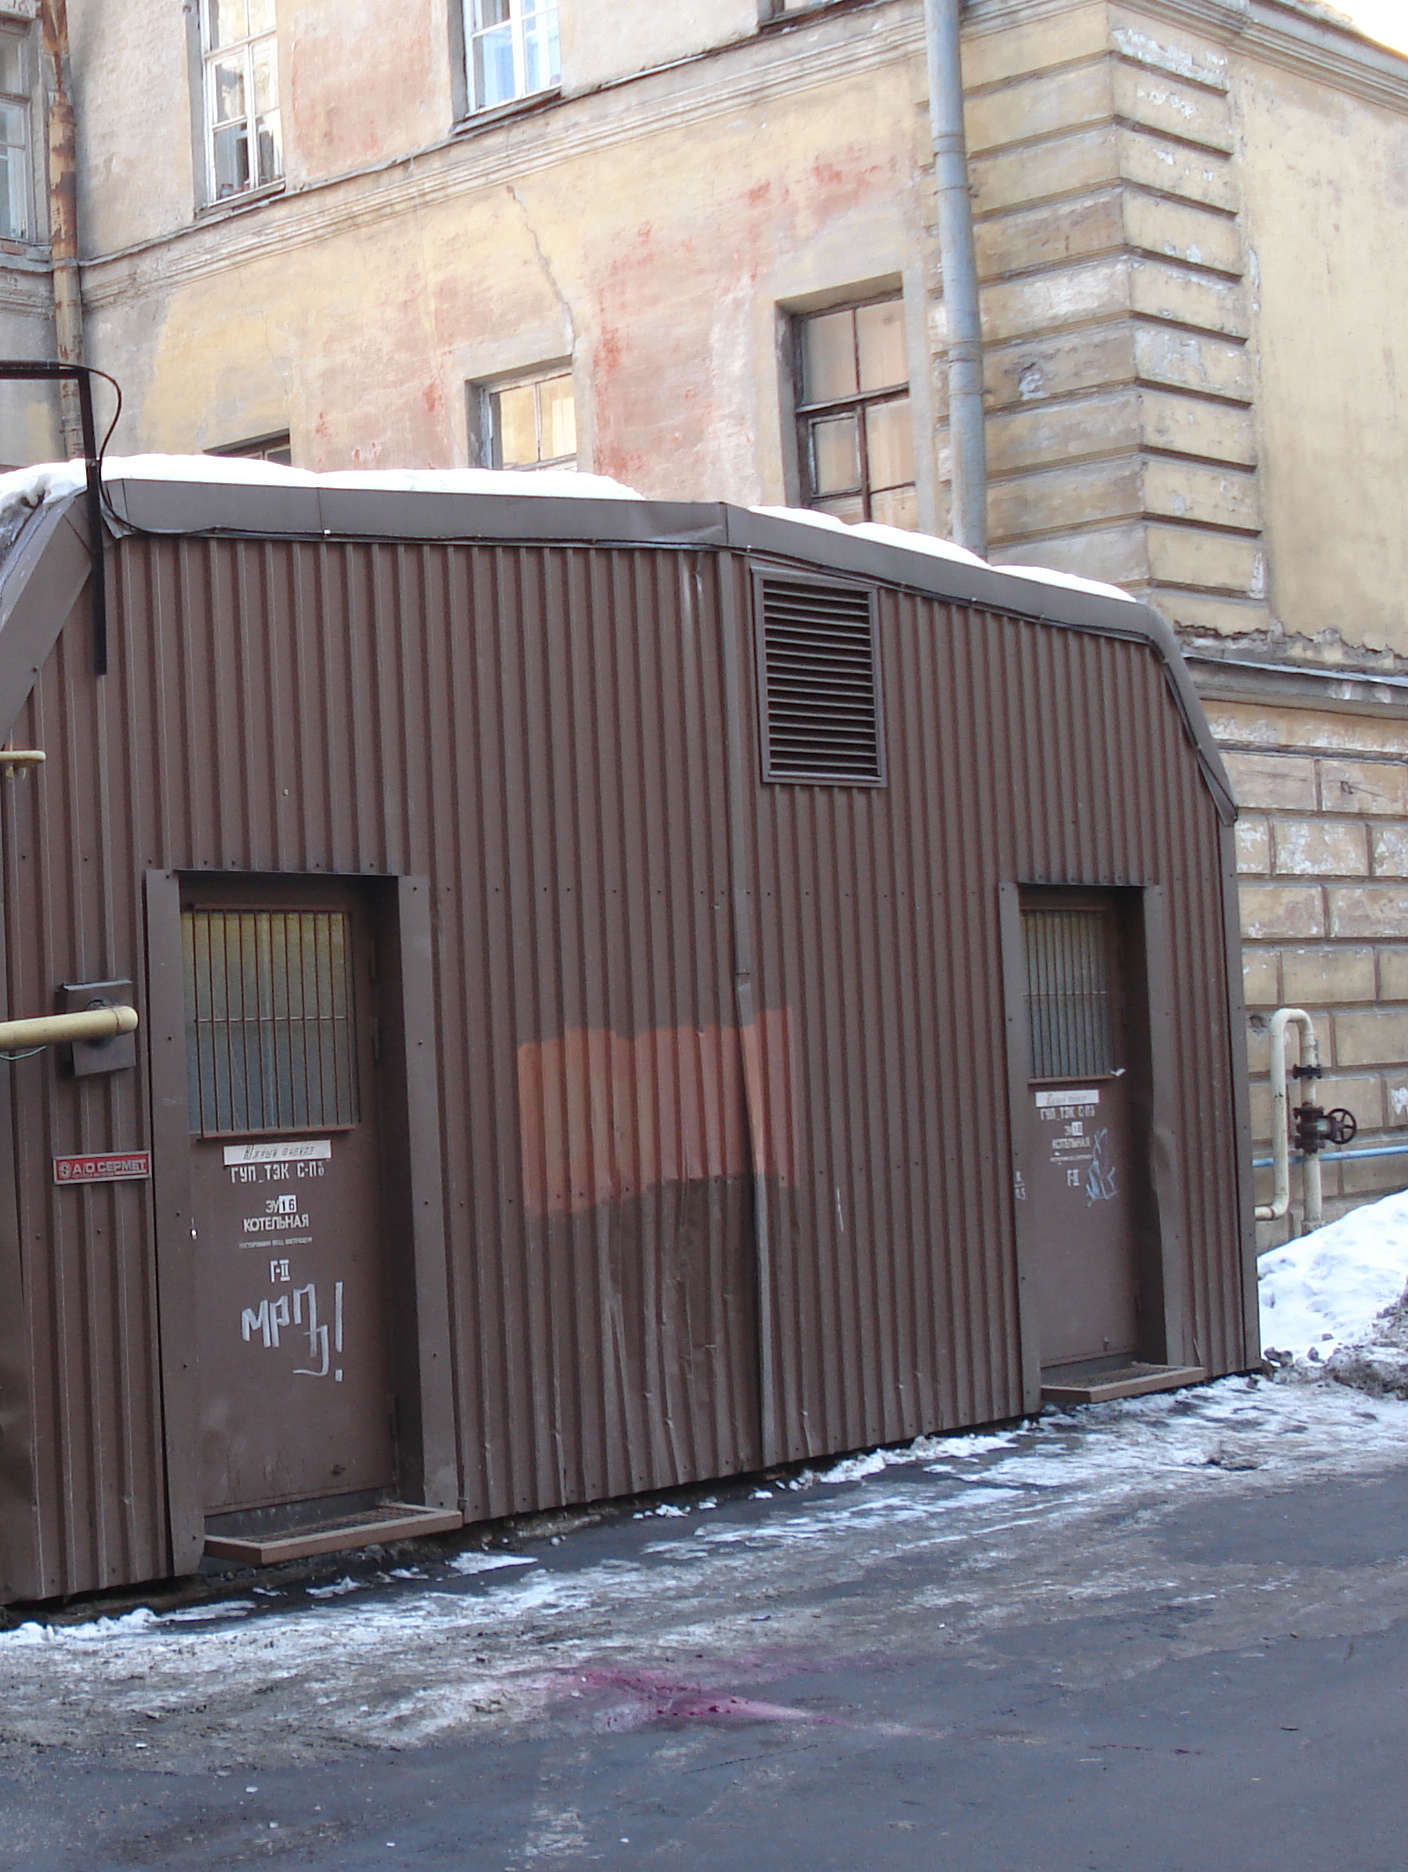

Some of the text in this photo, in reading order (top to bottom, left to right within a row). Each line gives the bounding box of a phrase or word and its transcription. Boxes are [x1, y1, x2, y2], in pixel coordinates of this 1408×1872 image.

[97, 1159, 146, 1172] СЕРМЕТ
[232, 1165, 256, 1183] ГУП
[243, 1214, 309, 1232] КОТЕЛЬНАЯ
